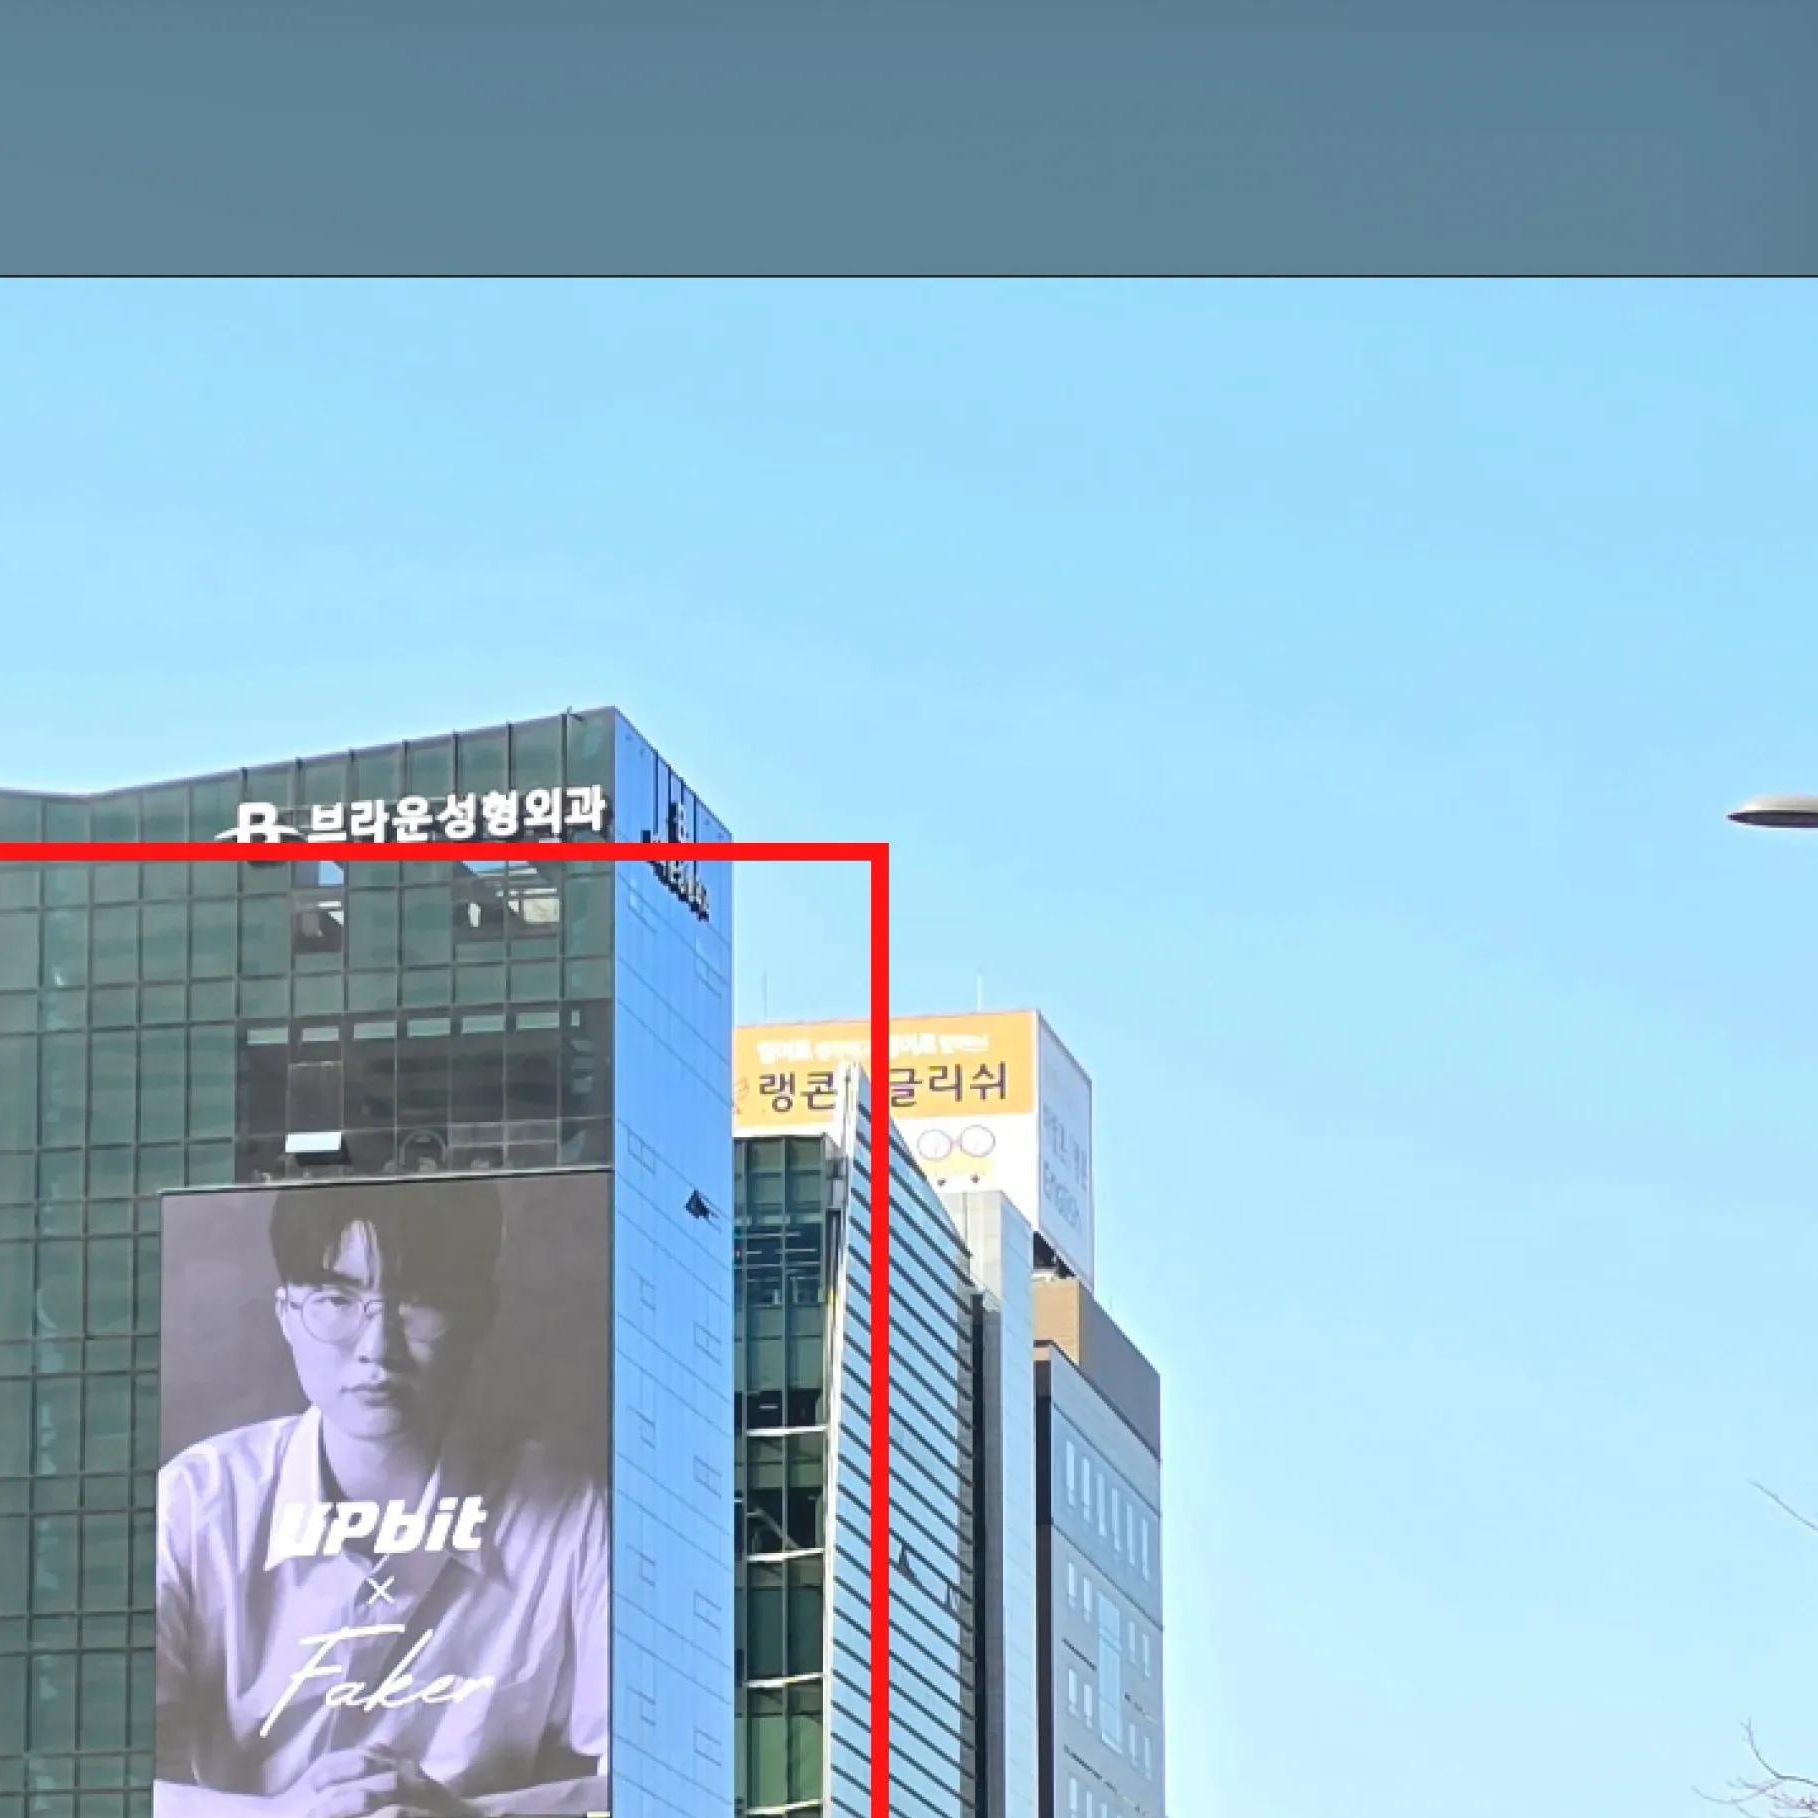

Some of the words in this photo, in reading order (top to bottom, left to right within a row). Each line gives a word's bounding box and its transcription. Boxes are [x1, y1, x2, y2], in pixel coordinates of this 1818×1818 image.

[308, 784, 608, 843] 브라운성형외과
[759, 1061, 1008, 1113] 랭콘글리쉬
[260, 1623, 495, 1738] Faker
